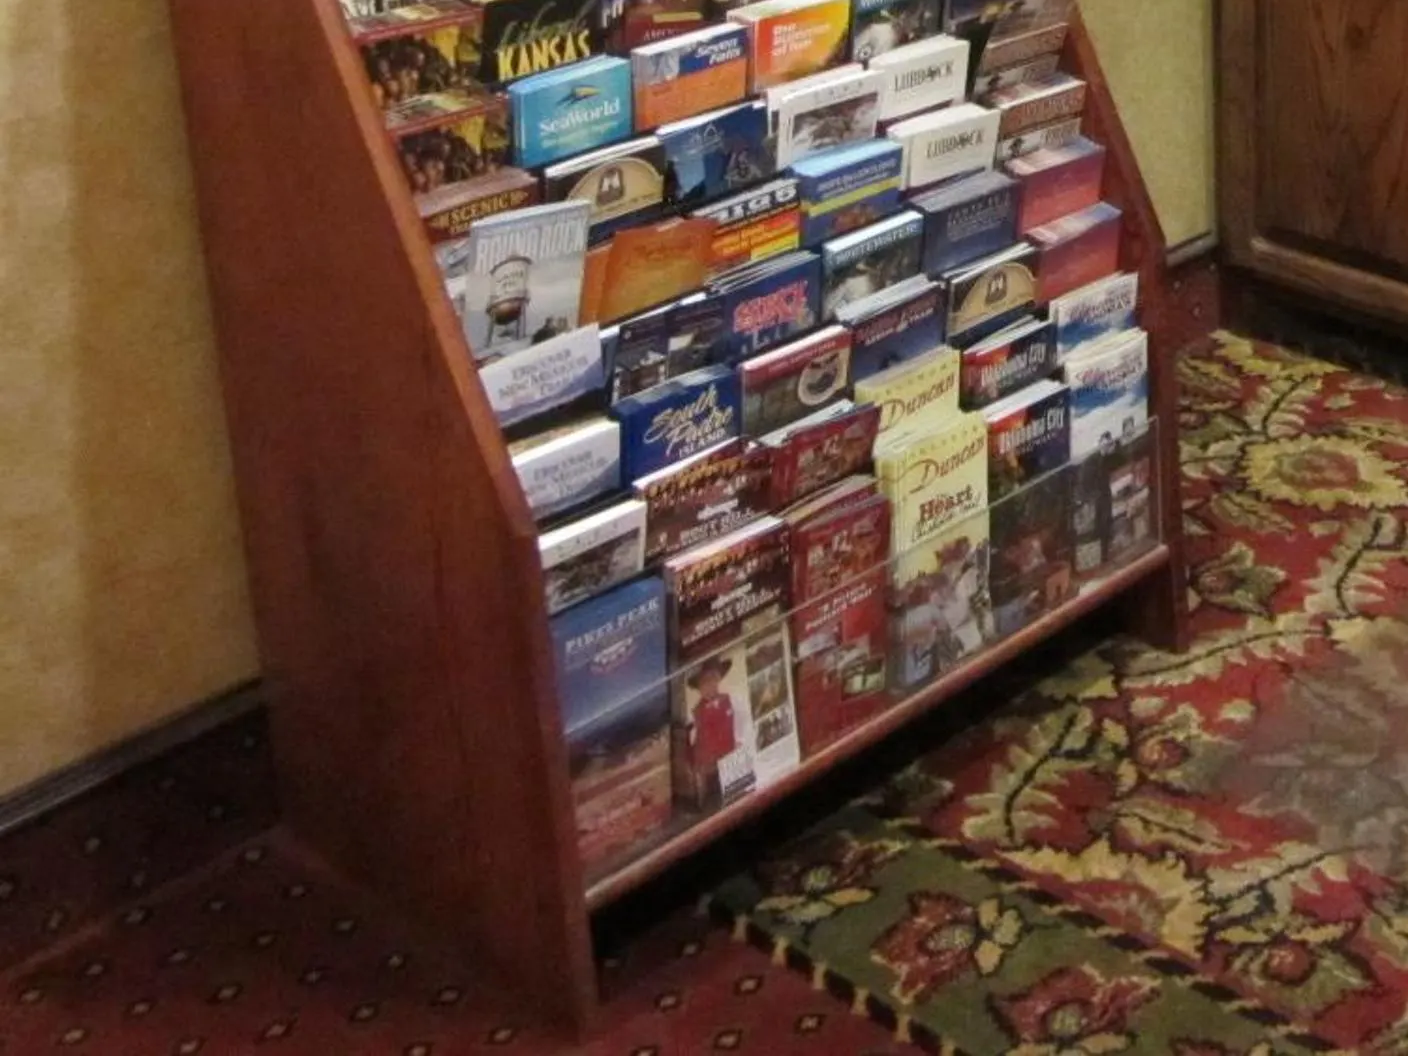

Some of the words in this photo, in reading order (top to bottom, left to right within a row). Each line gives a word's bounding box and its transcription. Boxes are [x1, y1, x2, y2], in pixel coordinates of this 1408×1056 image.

[496, 29, 592, 81] KANSAS
[538, 96, 621, 135] SeaWorld
[449, 193, 513, 224] SCENIC
[475, 226, 541, 275] ROUND
[541, 218, 588, 258] ROCK
[880, 372, 957, 434] Duncan
[878, 434, 987, 495] Duncan
[919, 484, 974, 520] Heart
